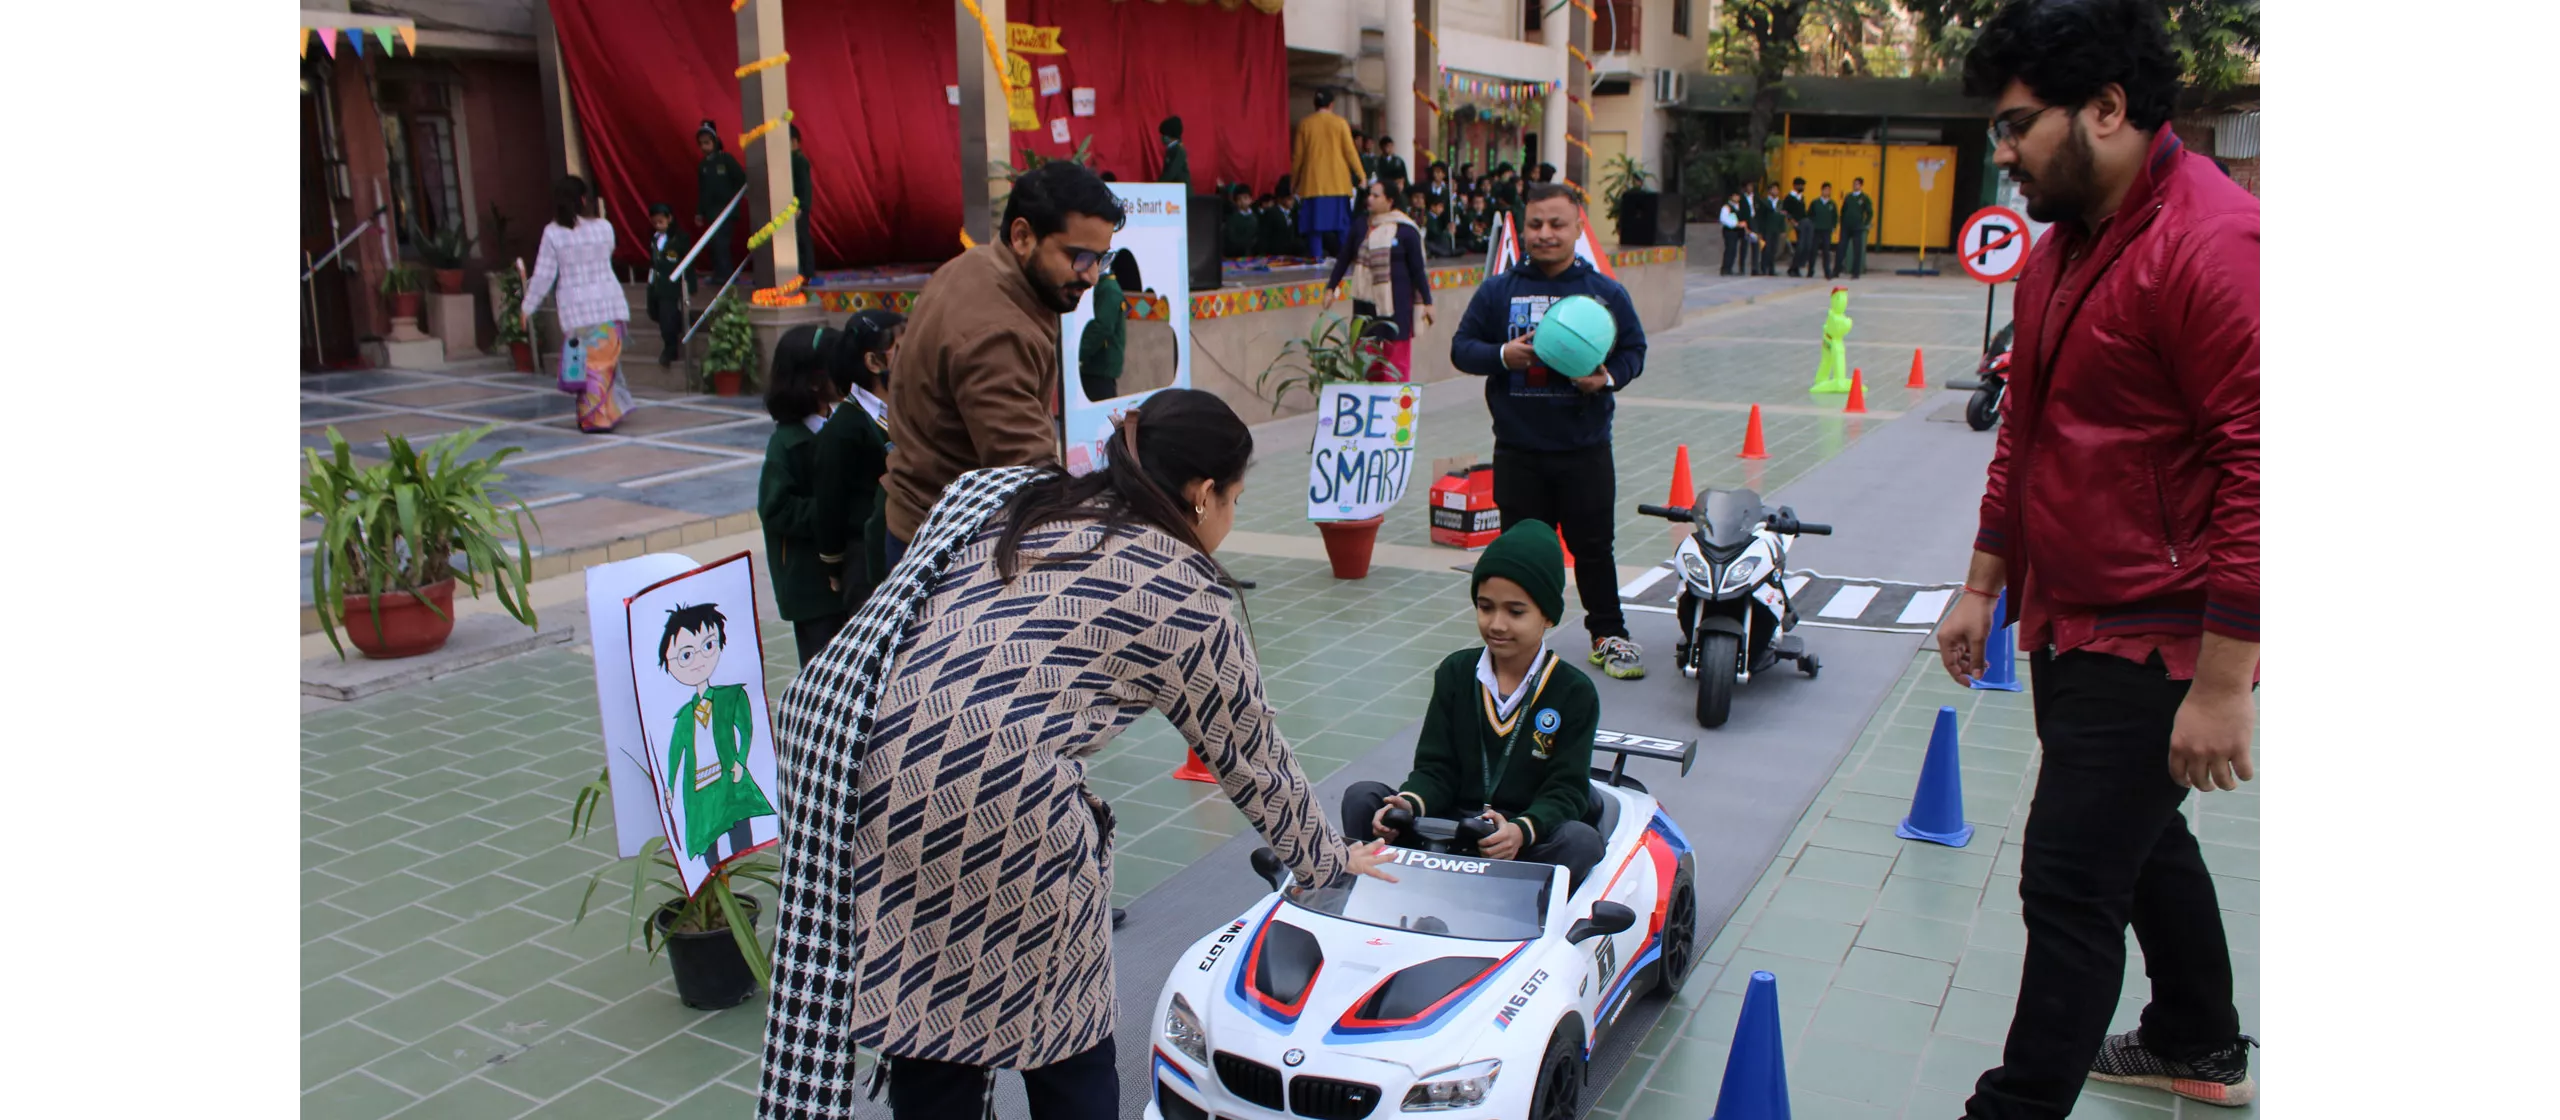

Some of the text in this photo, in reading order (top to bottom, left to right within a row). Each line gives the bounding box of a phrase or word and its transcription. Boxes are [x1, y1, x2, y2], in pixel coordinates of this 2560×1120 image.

[1123, 198, 1134, 214] Be
[1137, 198, 1162, 214] Smart
[1978, 224, 2012, 265] P
[1333, 393, 1391, 438] BE
[1310, 447, 1414, 504] SMART
[1595, 729, 1684, 751] GT3
[1406, 851, 1490, 874] Power
[1199, 924, 1243, 972] M6 GT3
[1500, 968, 1550, 1021] M6 GT3
